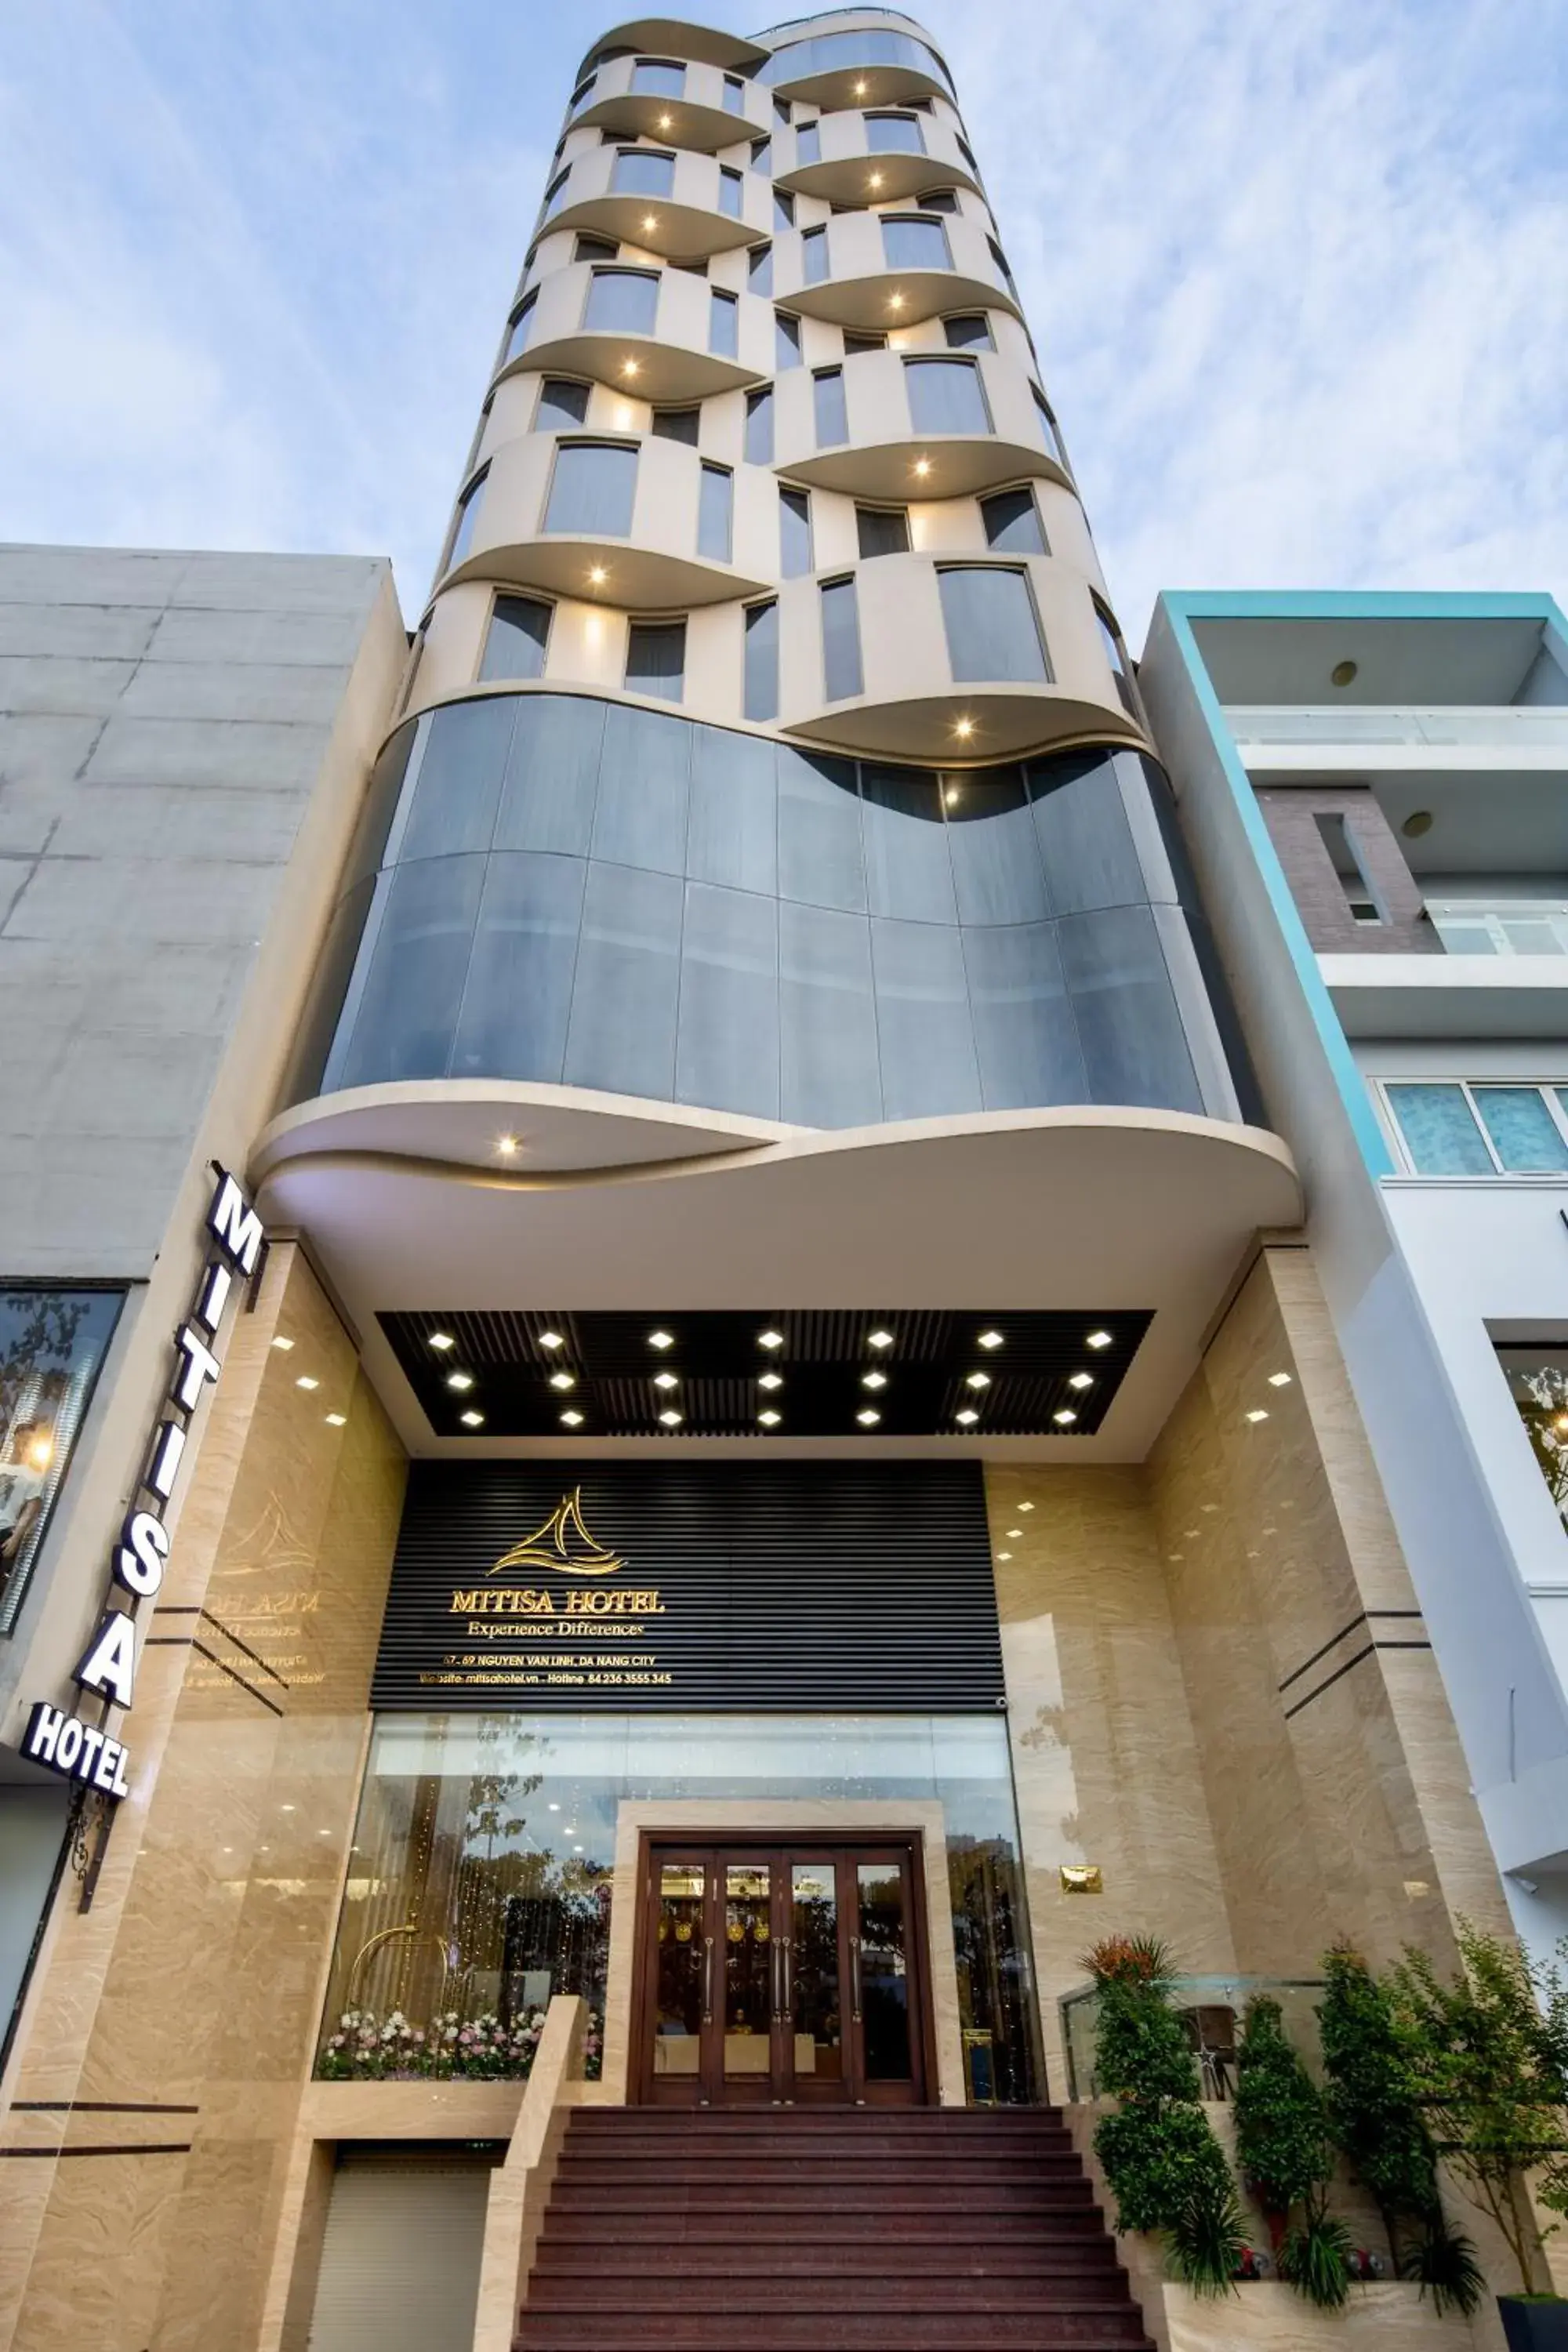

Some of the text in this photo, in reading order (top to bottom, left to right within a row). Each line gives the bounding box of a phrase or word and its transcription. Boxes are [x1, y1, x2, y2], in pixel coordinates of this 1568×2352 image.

[79, 1172, 263, 1710] MITISA
[448, 1590, 666, 1613] MITISA HOTEL
[467, 1621, 644, 1639] Experience Differences
[477, 1655, 524, 1666] NGUYEN
[526, 1655, 550, 1666] VAN
[579, 1655, 594, 1666] DA
[597, 1655, 630, 1666] NANG
[632, 1655, 656, 1666] CITY
[602, 1673, 622, 1684] 236
[624, 1673, 650, 1684] 3555
[652, 1673, 672, 1685] 345
[29, 1706, 130, 1800] HOTEL
